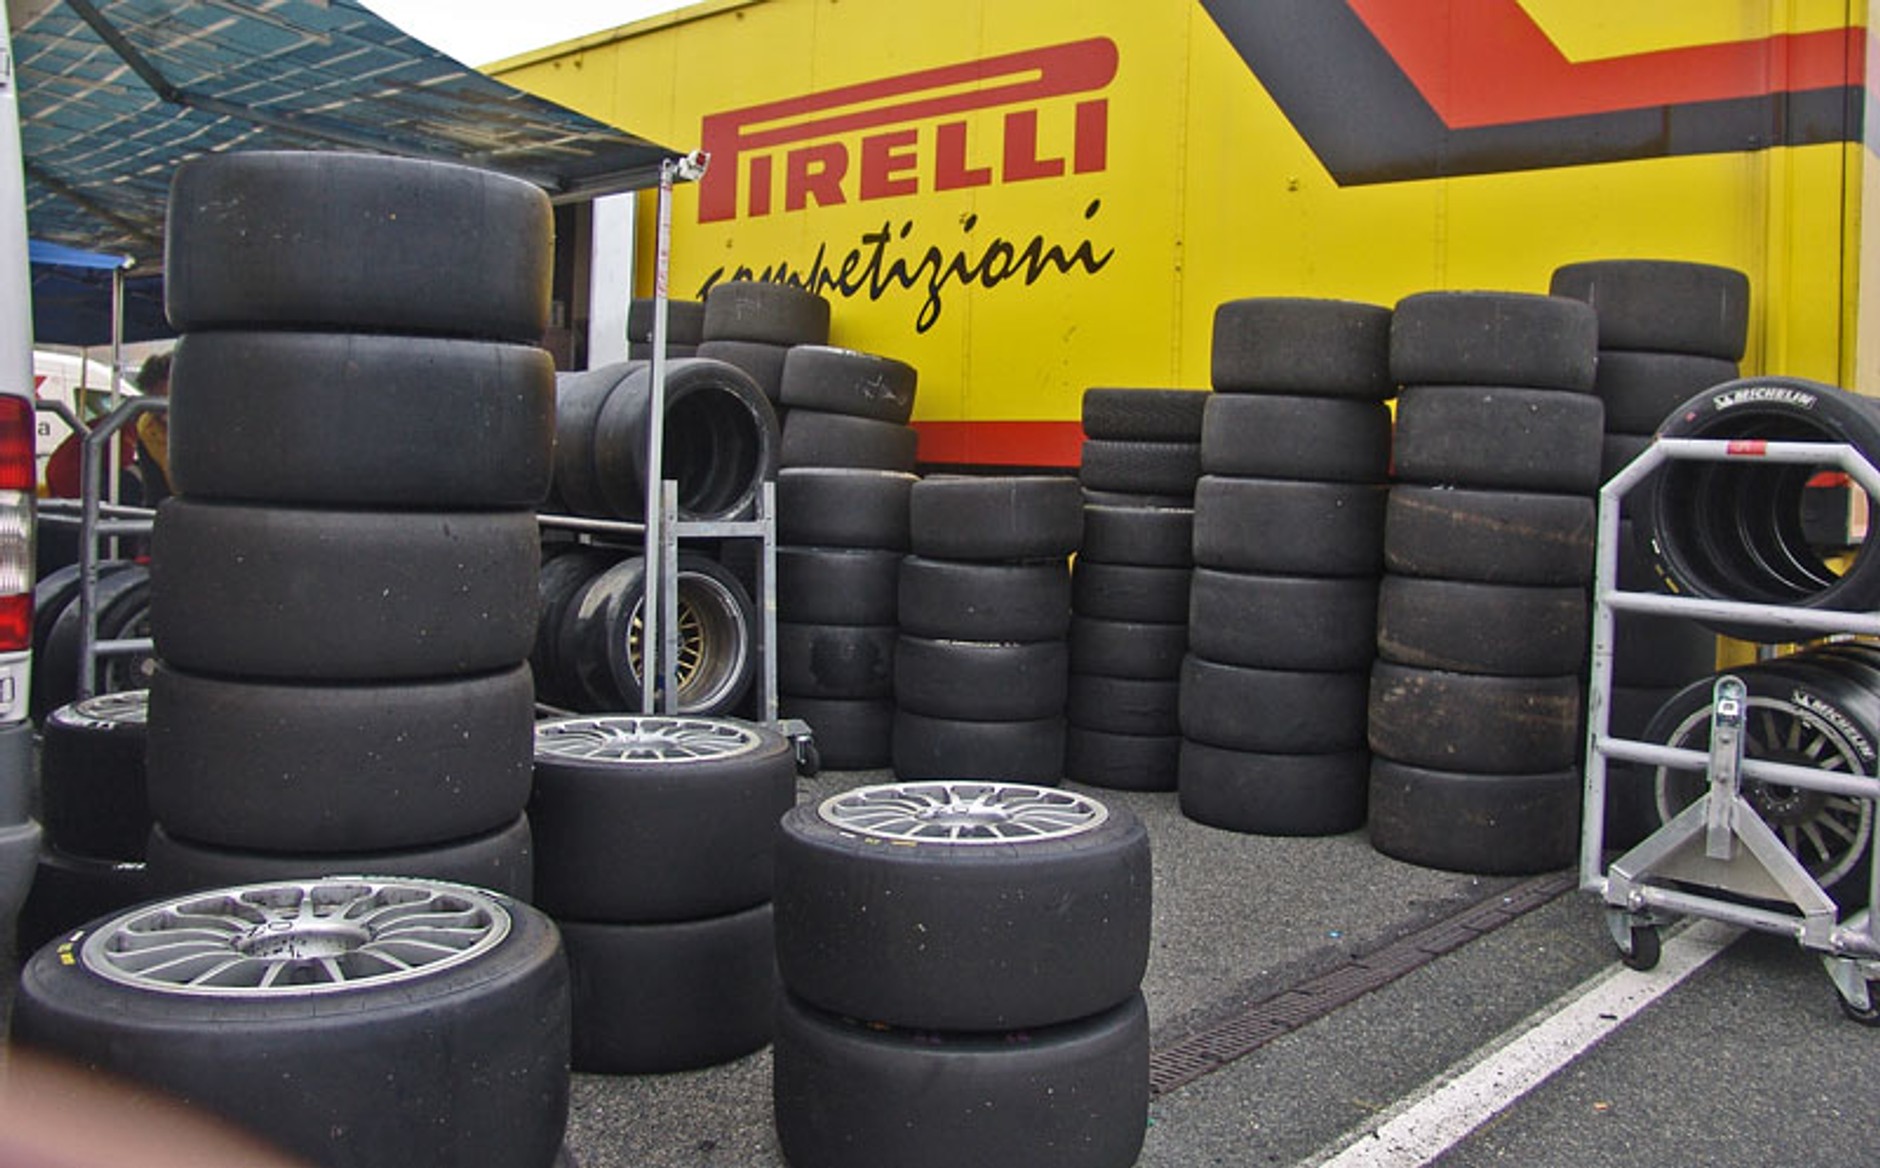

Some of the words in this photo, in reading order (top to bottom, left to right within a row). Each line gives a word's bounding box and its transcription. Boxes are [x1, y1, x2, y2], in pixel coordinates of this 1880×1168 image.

[698, 36, 1119, 224] PIRELLI
[1733, 387, 1818, 410] MICHELIN
[1811, 699, 1876, 761] MICHELIN
